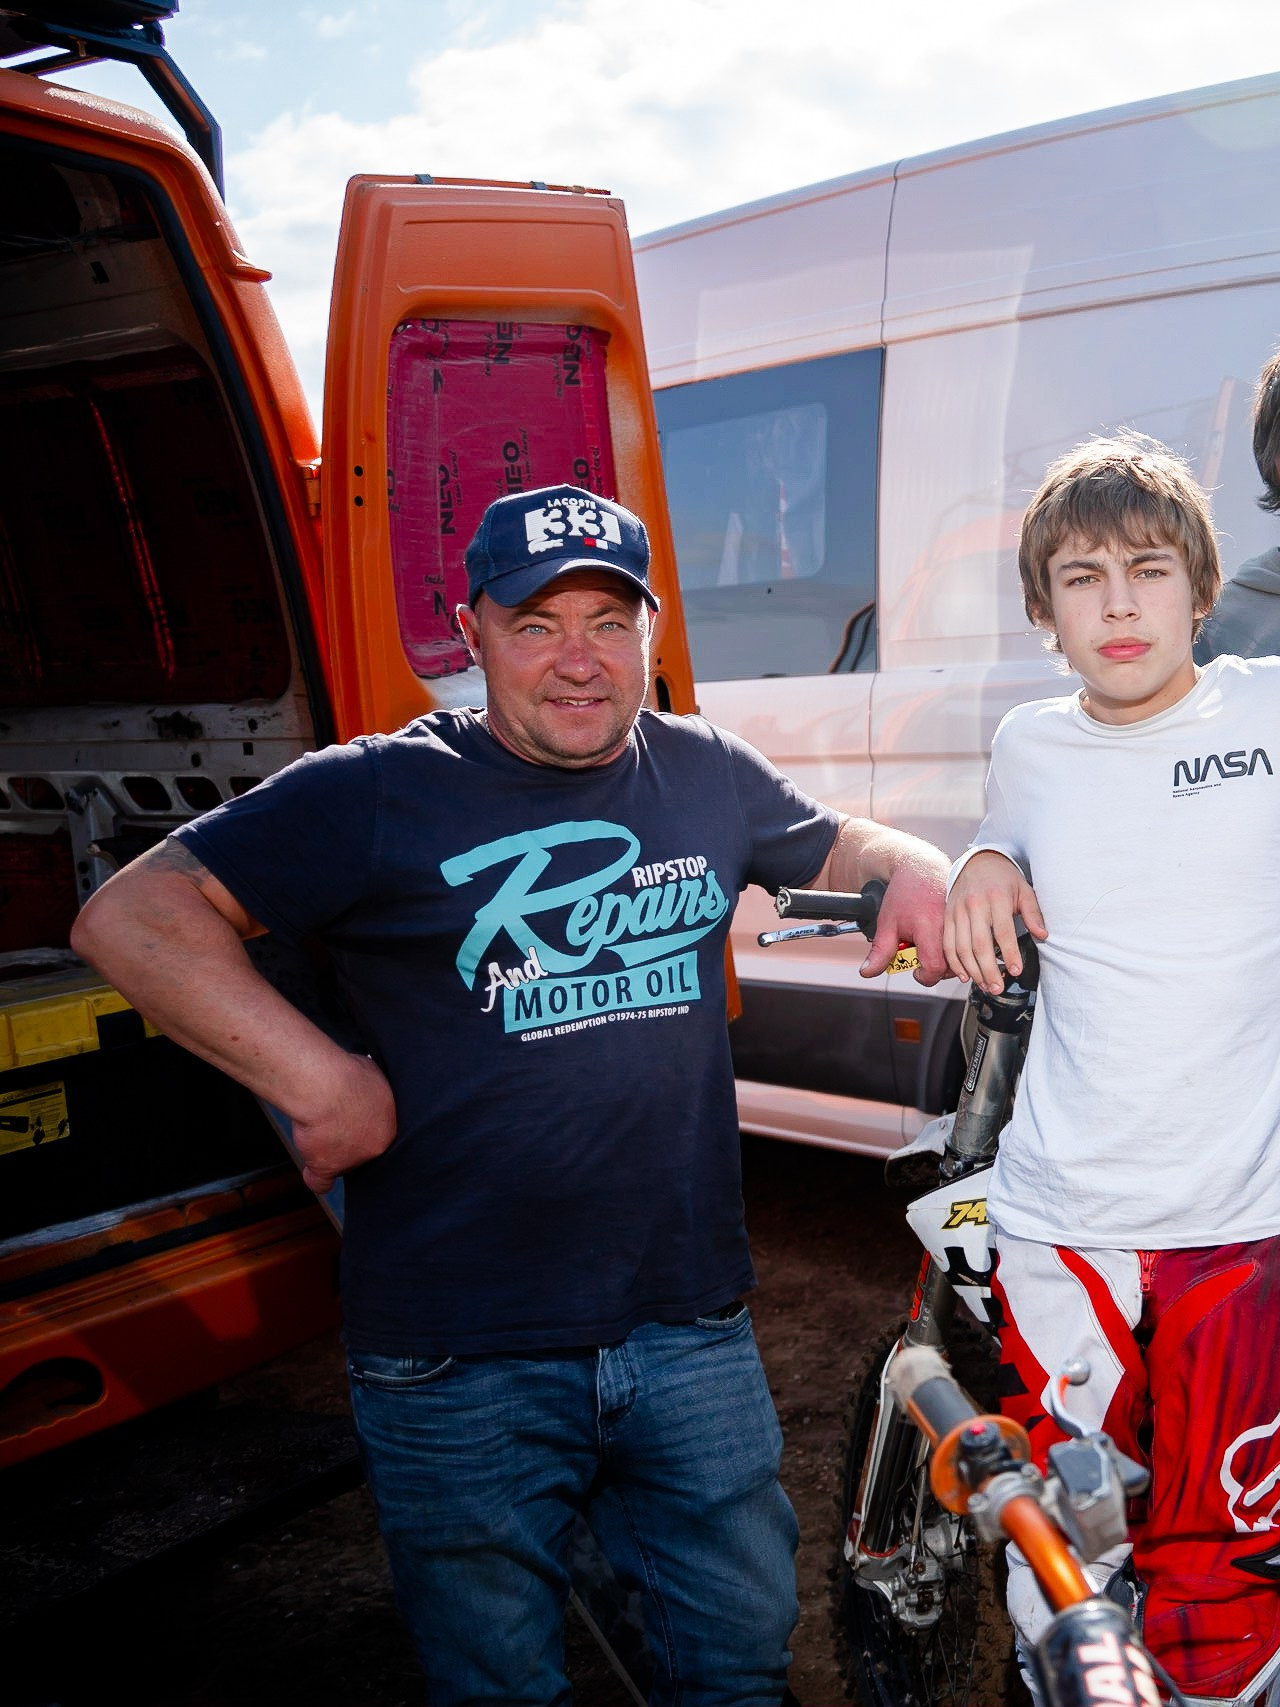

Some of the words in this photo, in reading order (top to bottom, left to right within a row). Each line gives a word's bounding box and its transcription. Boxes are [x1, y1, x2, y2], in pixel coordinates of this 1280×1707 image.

[547, 498, 597, 510] LACOSTE
[1174, 747, 1274, 787] NASA
[631, 855, 708, 888] RIPSTOP
[440, 819, 729, 991] Repairs
[481, 946, 548, 1012] And
[889, 956, 920, 971] CAMEL
[514, 976, 633, 1021] MOTOR
[646, 961, 692, 998] OIL
[521, 1027, 553, 1042] GLOBAL
[554, 1015, 607, 1036] REDEMPTION
[648, 1006, 677, 1018] RIPSTOP
